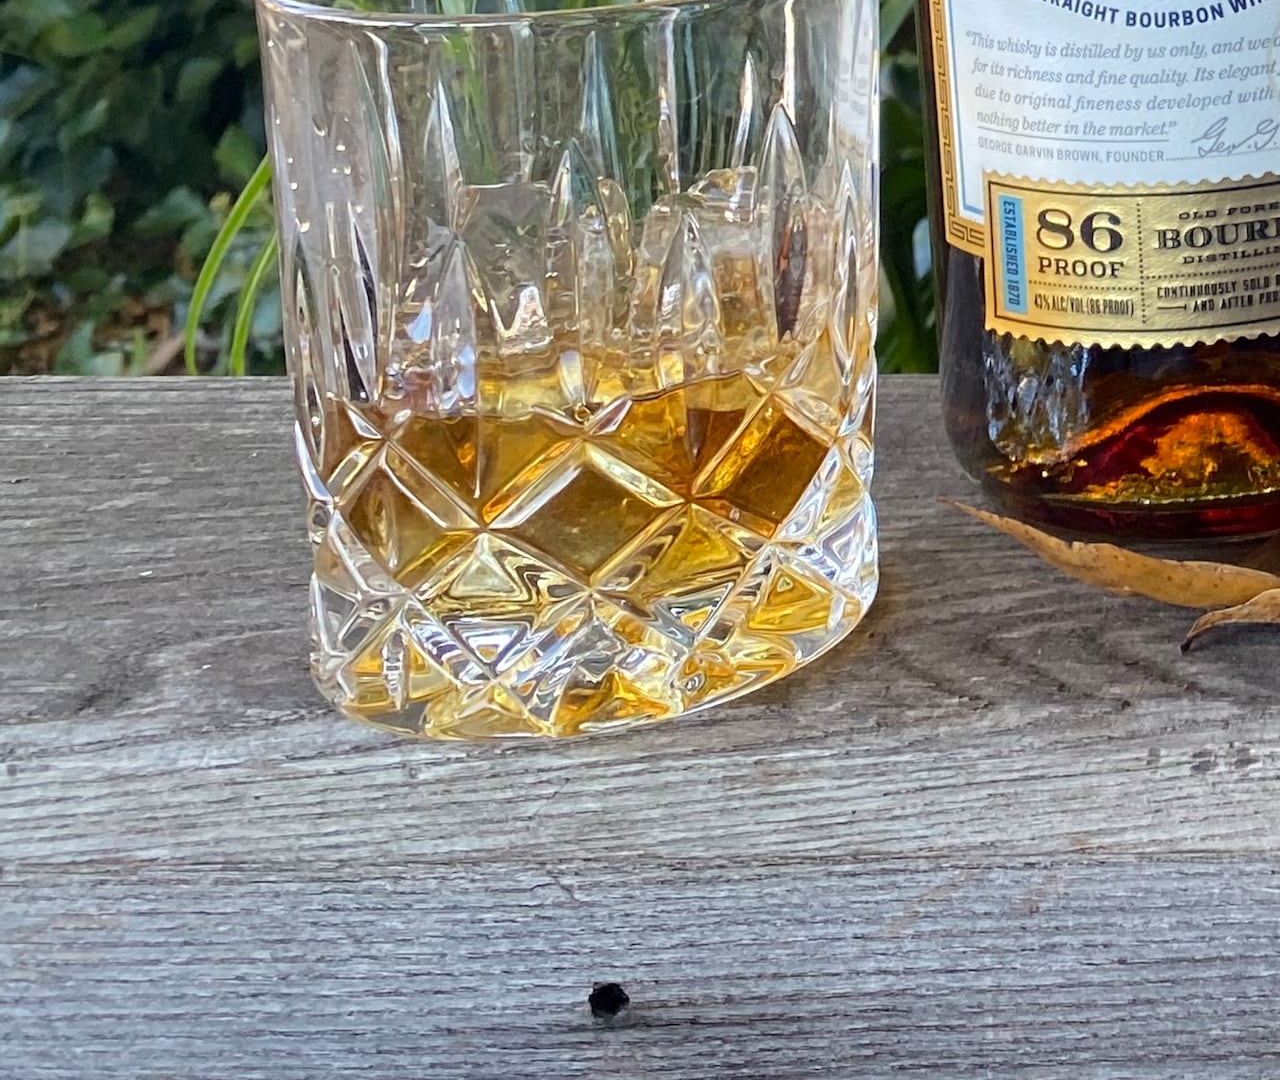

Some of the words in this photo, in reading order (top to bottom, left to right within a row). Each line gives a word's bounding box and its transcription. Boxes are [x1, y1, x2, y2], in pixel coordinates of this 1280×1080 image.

[1126, 3, 1224, 29] BOURBON
[997, 38, 1041, 58] whisky
[1045, 42, 1056, 57] is
[1060, 43, 1120, 59] distilled
[1125, 44, 1143, 62] by
[1148, 46, 1165, 58] us
[1212, 37, 1244, 54] and
[1248, 37, 1270, 49] we
[978, 136, 1012, 154] GEORGE
[1016, 142, 1053, 160] GARVIN
[1058, 148, 1102, 163] BROWN,
[1106, 149, 1164, 162] FOUNDER
[1179, 209, 1218, 221] OLD
[1003, 200, 1019, 275] ESTABLISHED
[1036, 208, 1124, 253] 86
[1038, 256, 1124, 279] PROOF
[1008, 279, 1020, 306] 1870
[1052, 294, 1086, 314] ALC/VOL
